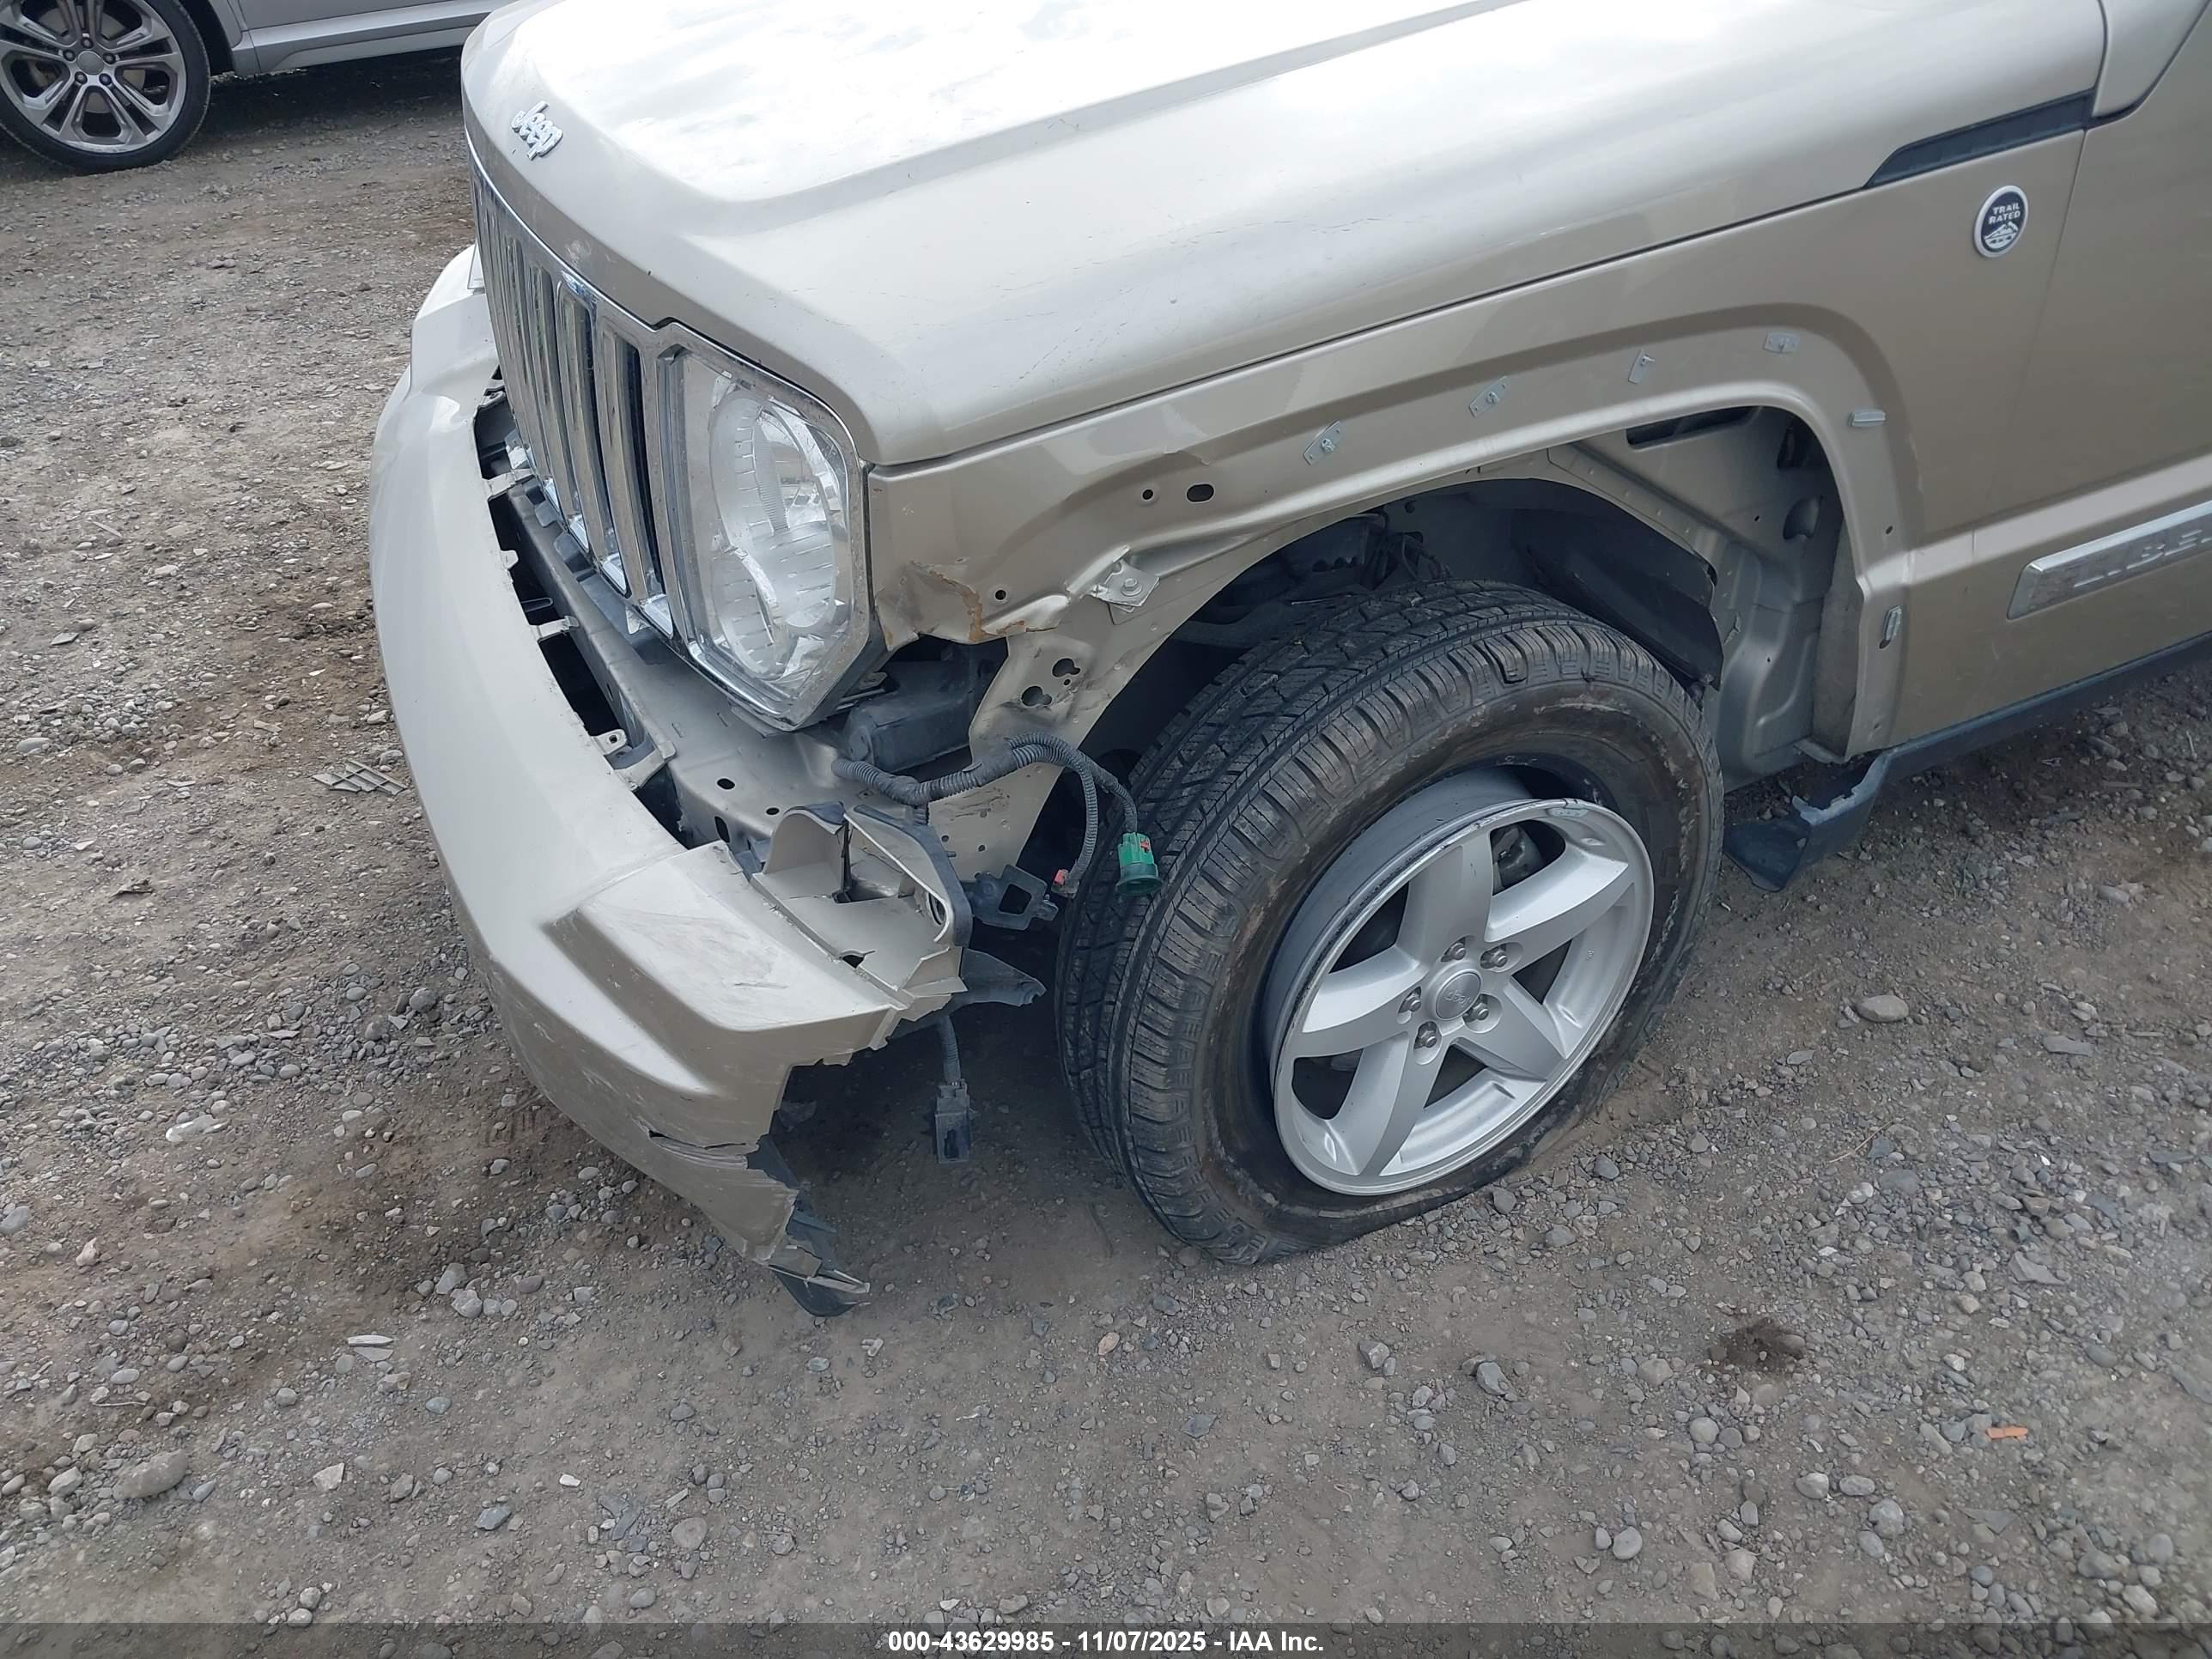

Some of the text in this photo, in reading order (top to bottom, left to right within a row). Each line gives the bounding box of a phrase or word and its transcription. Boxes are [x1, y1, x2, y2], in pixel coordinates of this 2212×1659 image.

[511, 100, 563, 161] Jeep
[1992, 202, 2020, 215] TRAIL
[1988, 210, 2021, 224] RATED
